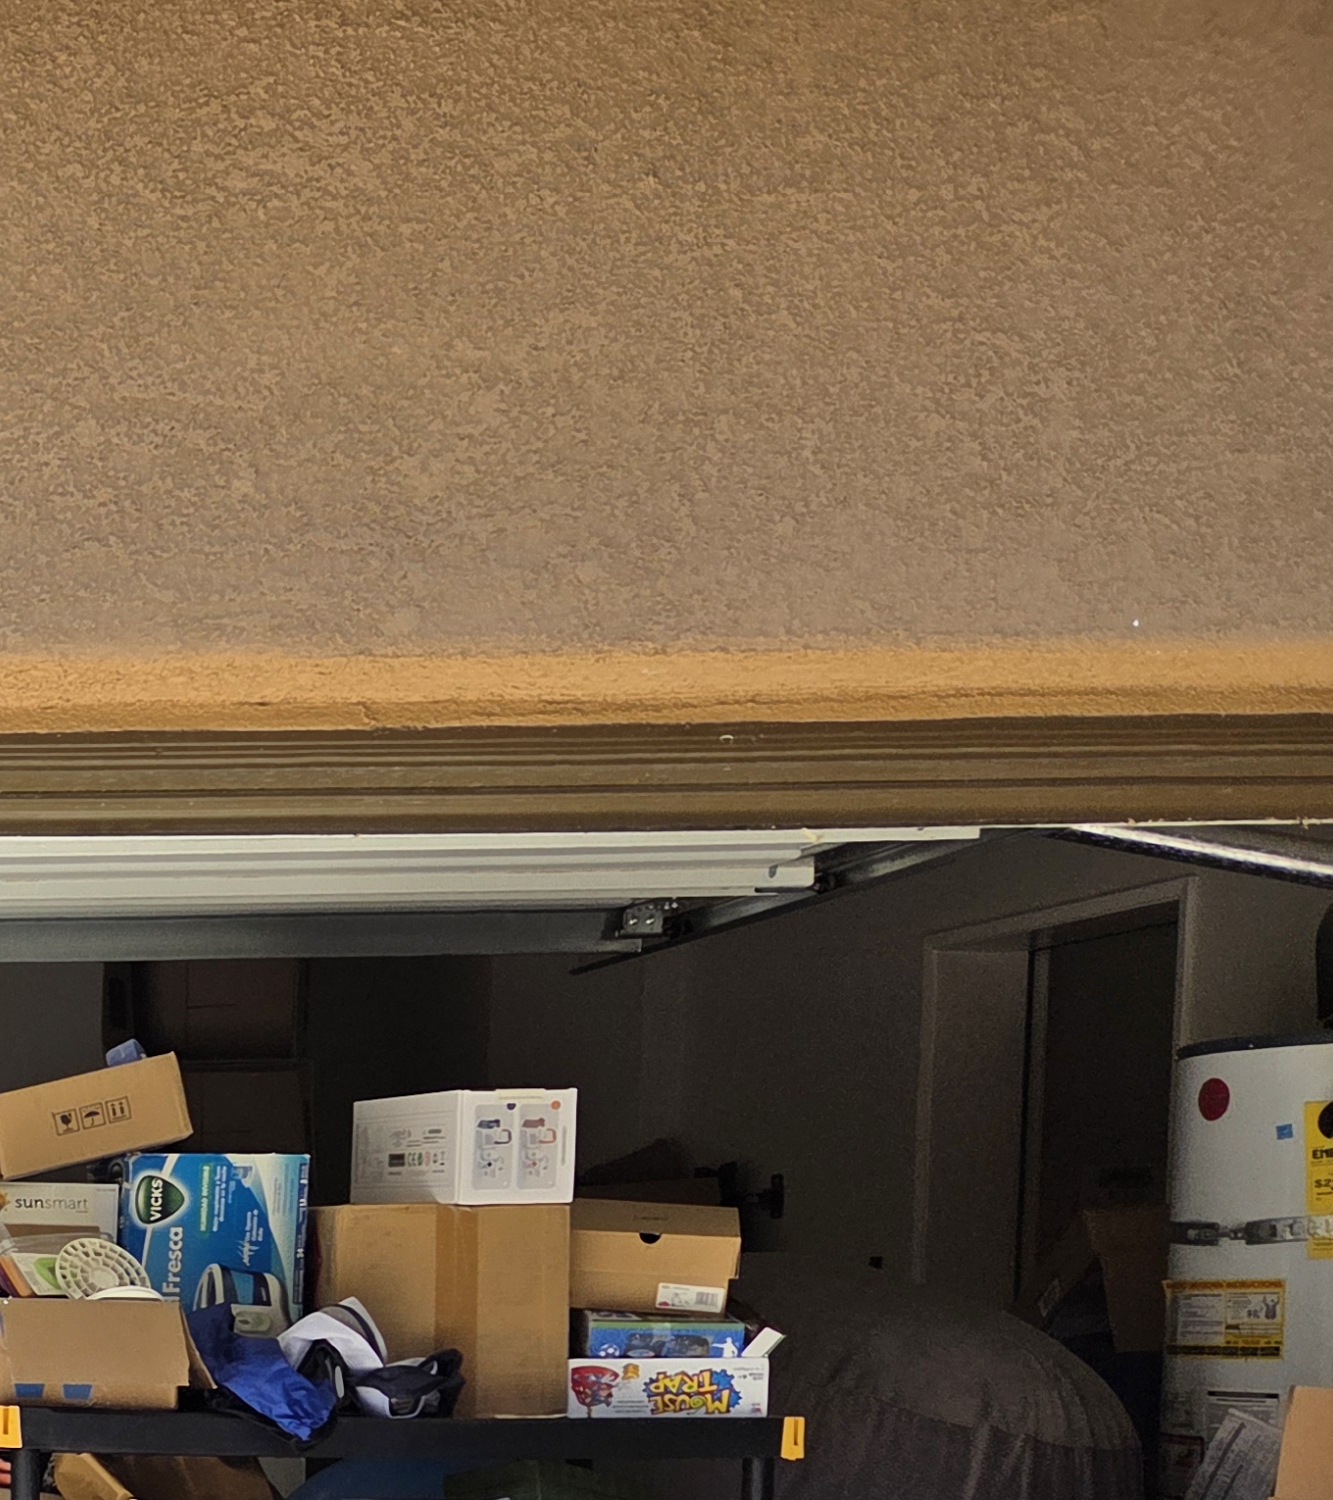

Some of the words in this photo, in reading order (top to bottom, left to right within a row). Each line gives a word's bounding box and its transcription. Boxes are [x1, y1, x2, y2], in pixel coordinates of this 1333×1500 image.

[14, 1197, 88, 1210] sunsmart
[149, 1177, 163, 1221] VICKS
[162, 1226, 183, 1293] Fresca
[649, 1370, 718, 1393] TRAP
[650, 1389, 731, 1415] MOUSE
